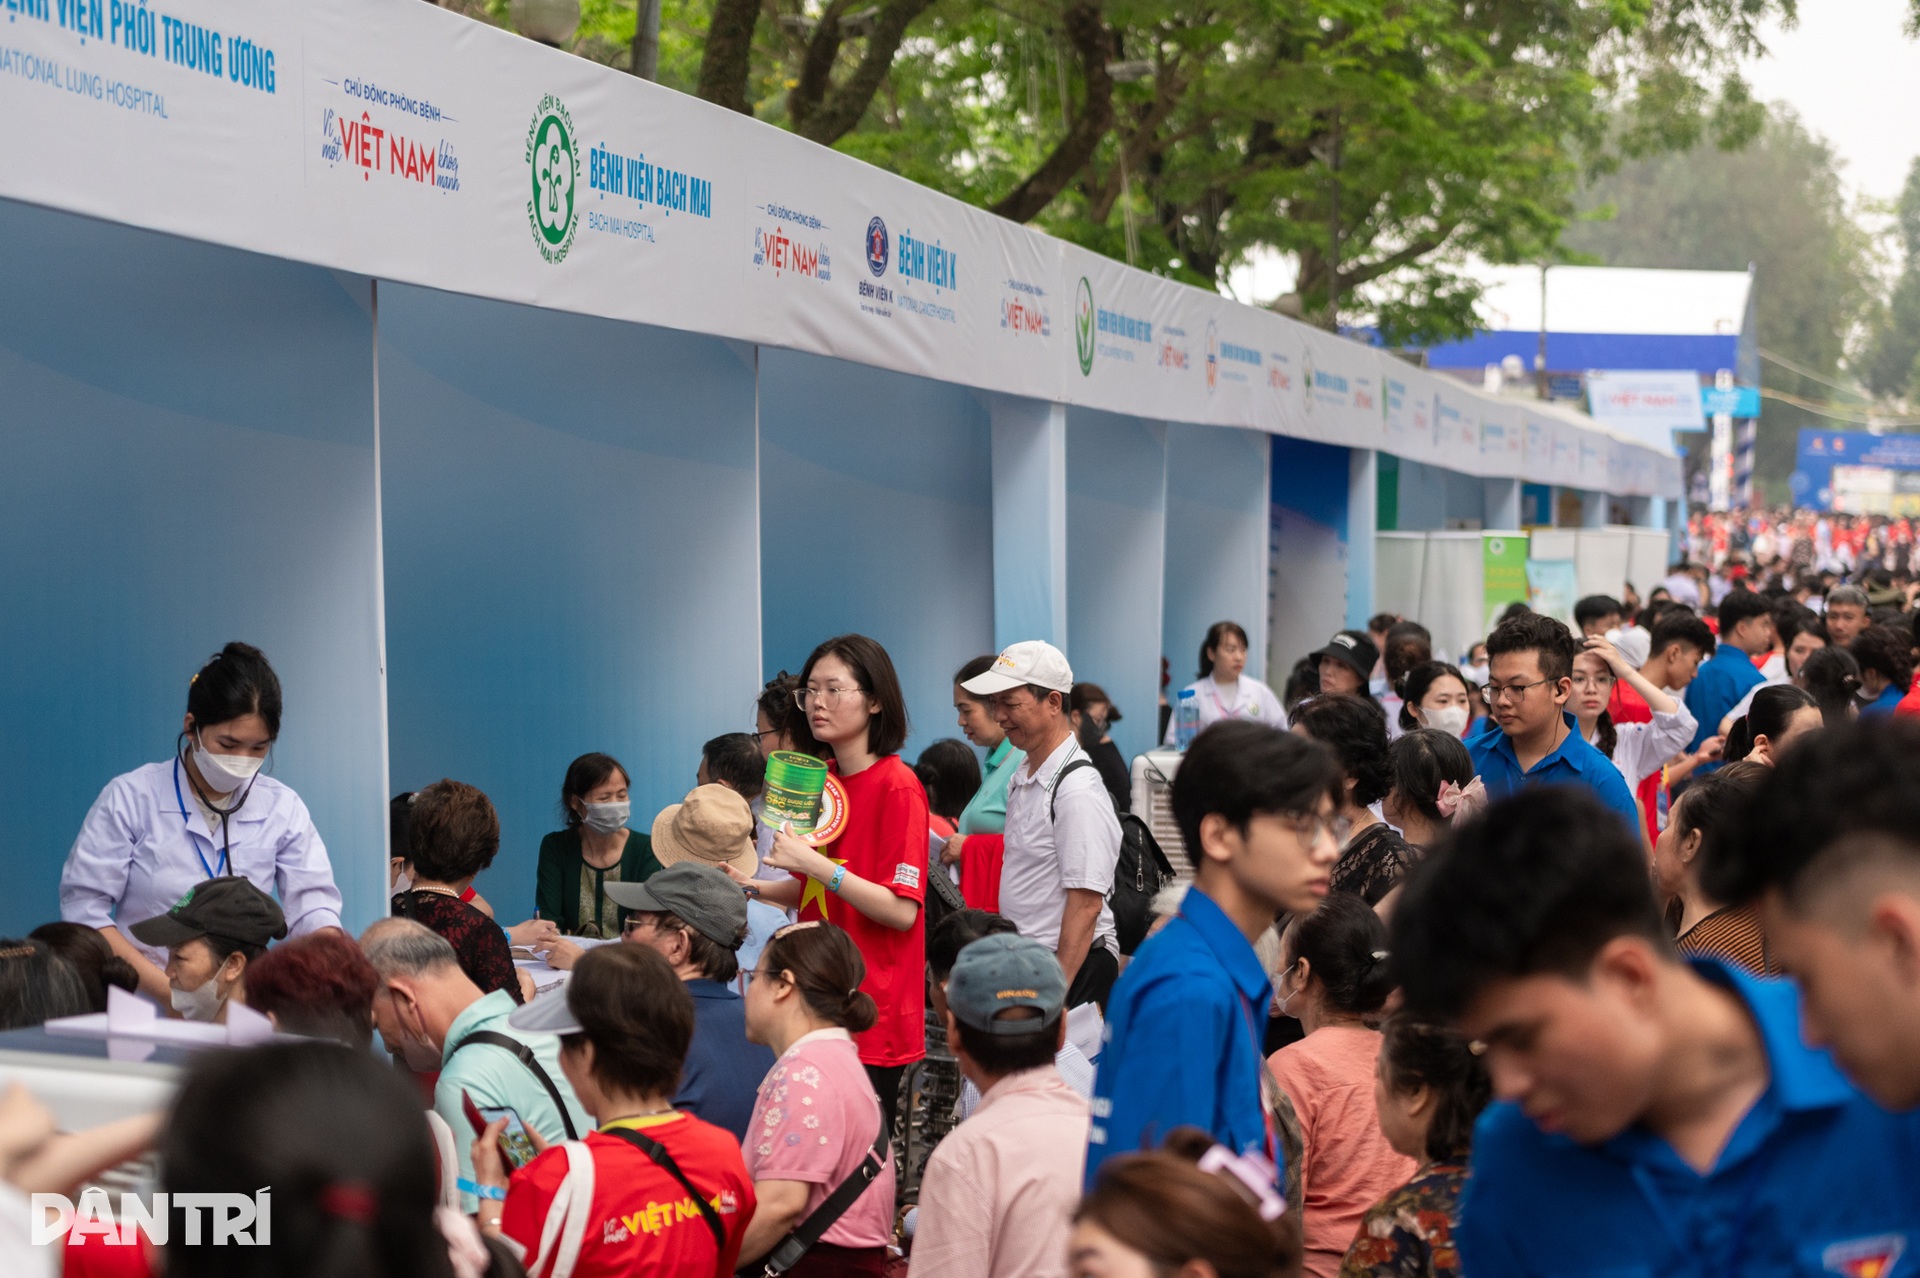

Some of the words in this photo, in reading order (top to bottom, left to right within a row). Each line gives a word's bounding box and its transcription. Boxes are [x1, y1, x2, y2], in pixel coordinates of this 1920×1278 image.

[161, 14, 222, 78] TRUNG
[228, 35, 275, 94] ƯƠNG
[66, 66, 102, 100] LUNG
[106, 79, 168, 119] HOSPITAL
[343, 77, 362, 98] CHỦ
[363, 83, 388, 106] ĐỘNG
[389, 92, 418, 115] PHÒNG
[419, 100, 441, 122] BỆNH
[321, 136, 342, 168] một
[338, 110, 384, 181] VIỆT
[389, 132, 435, 186] NAM
[590, 141, 623, 200] BỆNH
[626, 152, 653, 210] VIỆN
[656, 166, 687, 217] BẠCH
[689, 176, 711, 219] MAI
[589, 211, 609, 232] BACH
[609, 216, 622, 236] MAI
[623, 219, 655, 243] HOSPITAL
[764, 225, 790, 278] VIỆT
[791, 242, 818, 279] NAM
[898, 227, 924, 286] BỆNH
[926, 238, 948, 295] VIỆN
[949, 251, 957, 291] K
[765, 795, 786, 808] OPC
[621, 1200, 673, 1236] VIỆT
